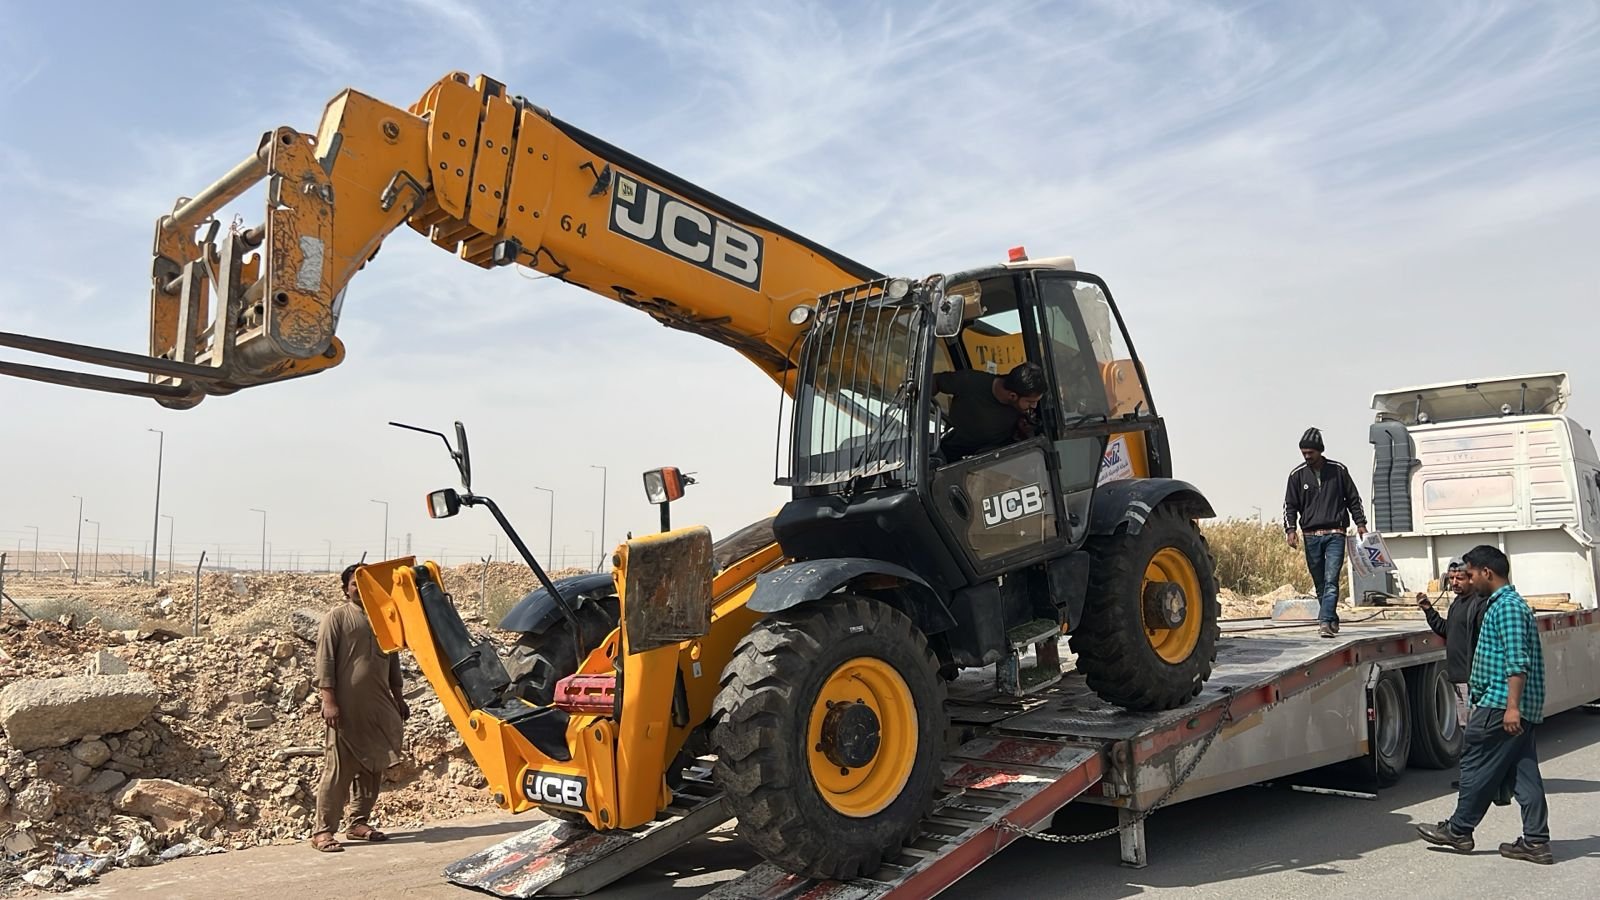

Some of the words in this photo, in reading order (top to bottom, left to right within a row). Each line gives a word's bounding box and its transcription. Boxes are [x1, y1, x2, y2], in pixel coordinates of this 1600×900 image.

[560, 215, 588, 239] 64
[615, 189, 759, 284] JCB
[985, 486, 1043, 525] JCB
[526, 776, 584, 807] JCB
